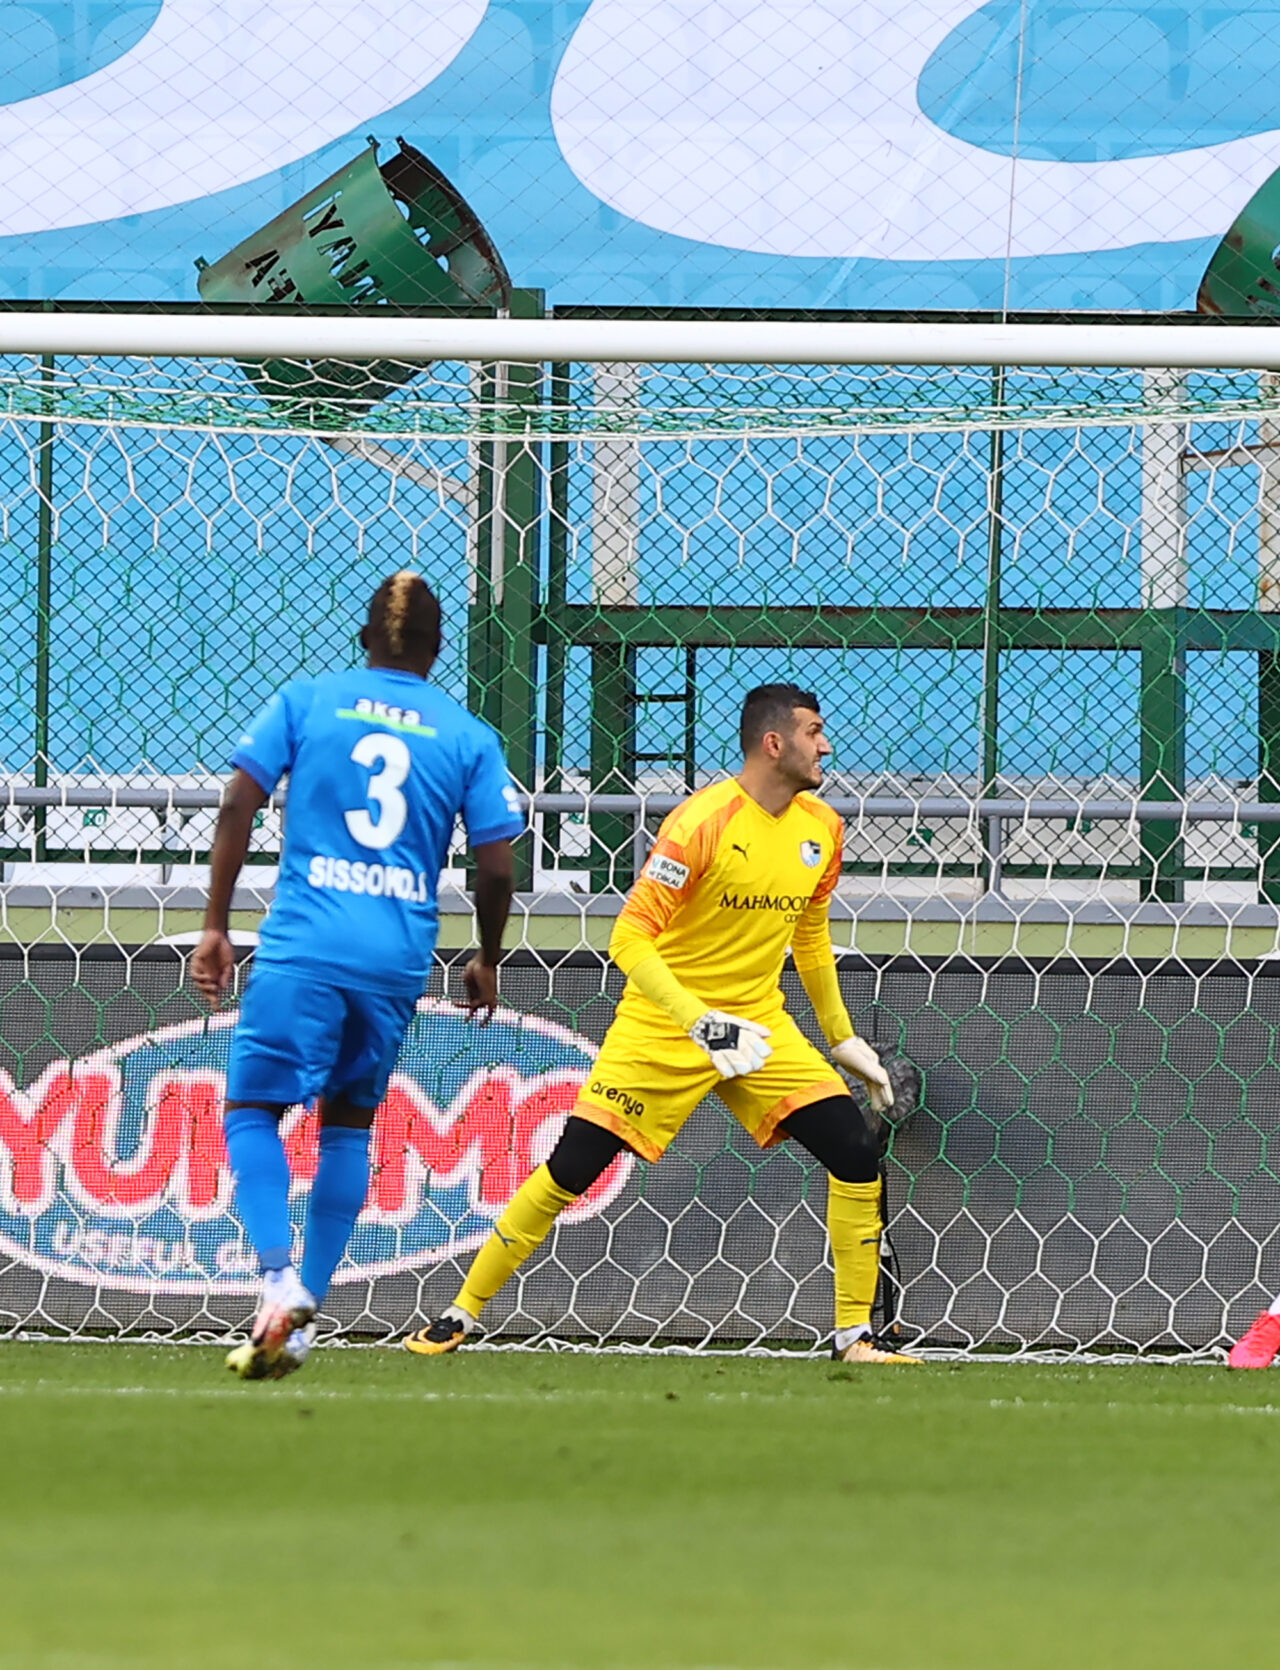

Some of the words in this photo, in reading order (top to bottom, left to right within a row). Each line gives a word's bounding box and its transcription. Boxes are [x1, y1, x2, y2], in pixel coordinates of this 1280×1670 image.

[344, 731, 411, 851] 3
[660, 859, 688, 878] BONA
[590, 1082, 645, 1116] arenya
